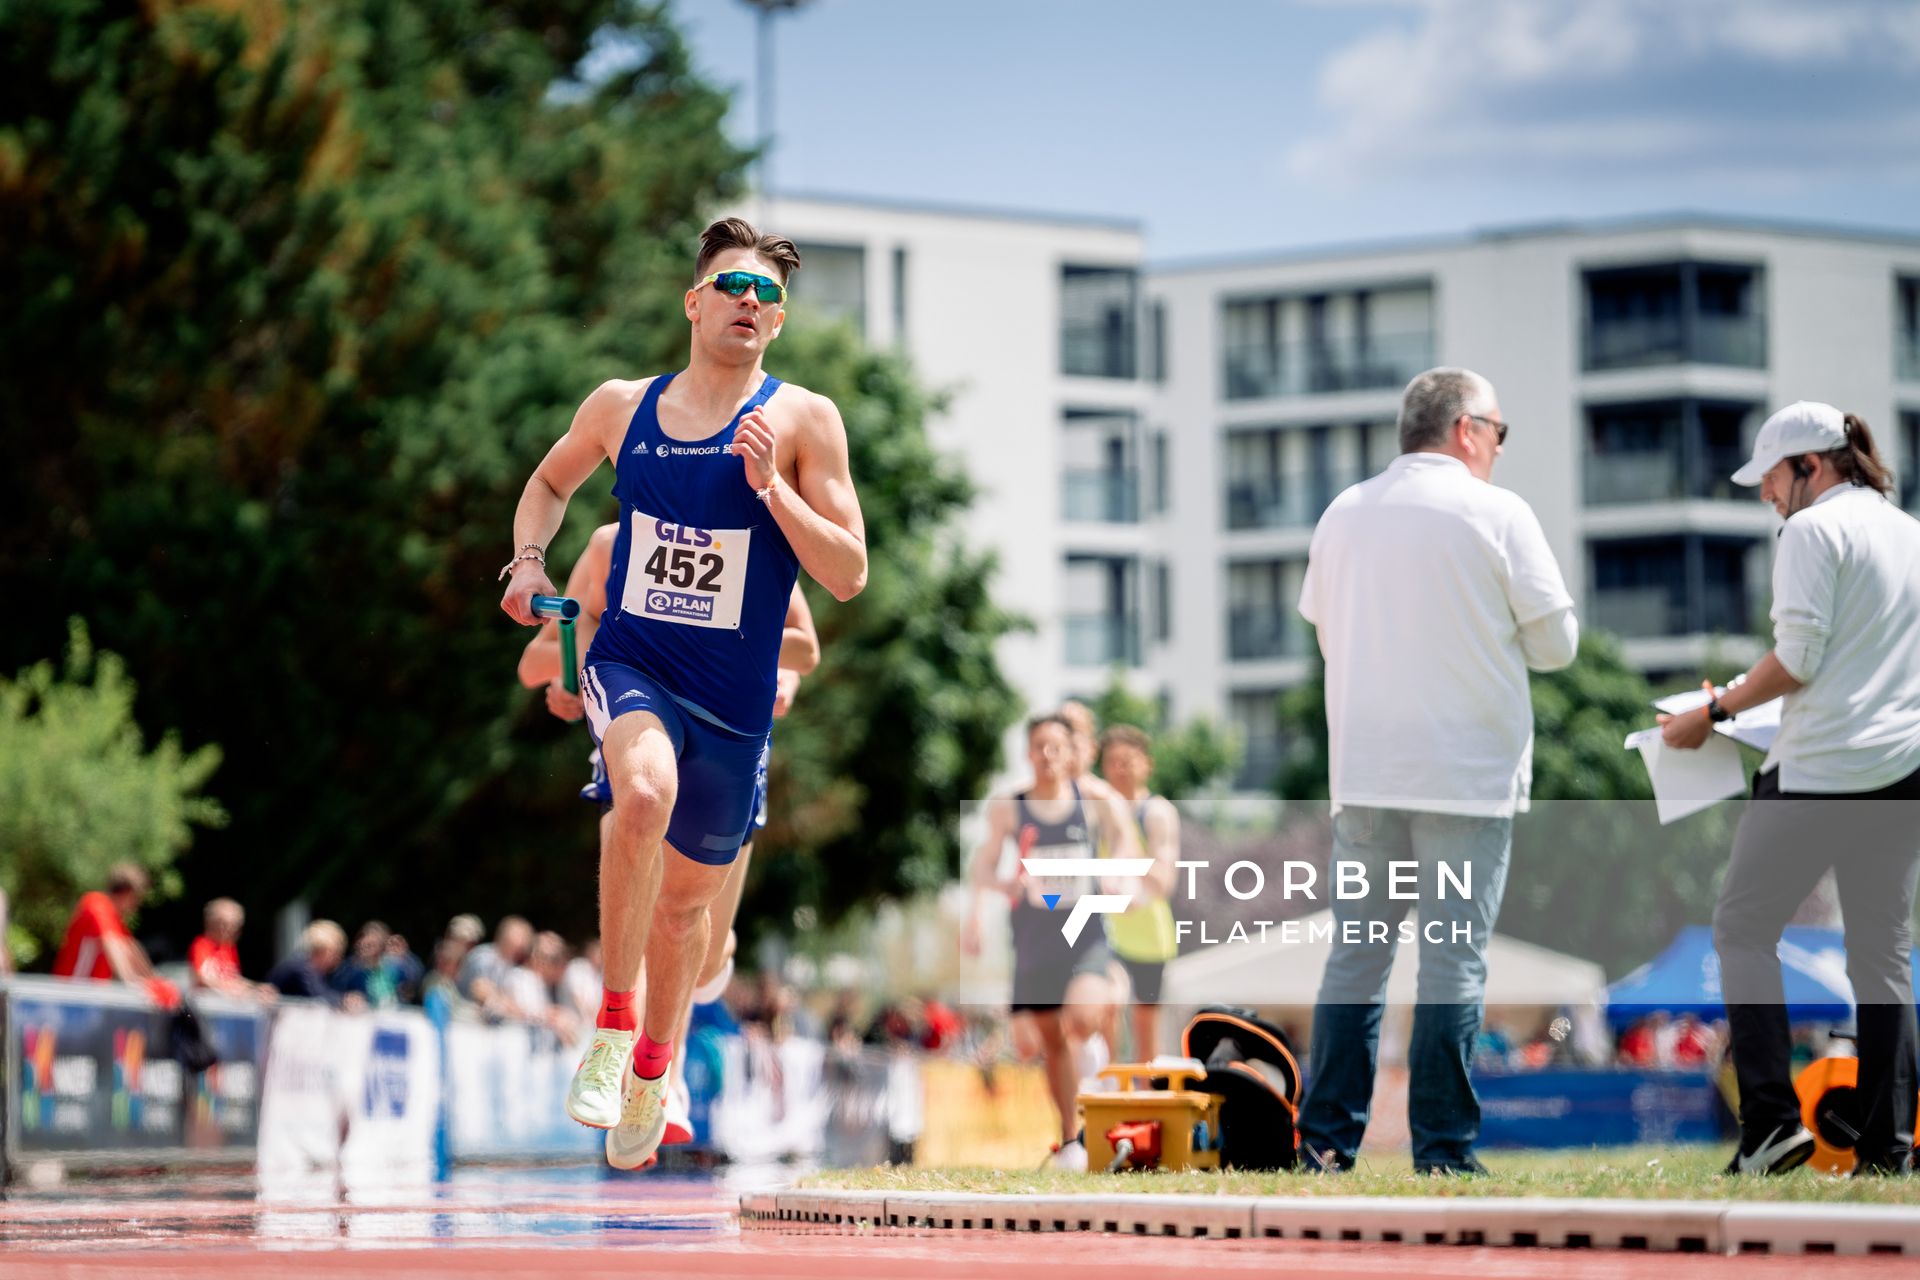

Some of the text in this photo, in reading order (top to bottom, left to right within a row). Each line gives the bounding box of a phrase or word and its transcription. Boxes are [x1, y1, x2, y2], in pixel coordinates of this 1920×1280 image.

[671, 446, 720, 456] NEUWOGES
[644, 545, 724, 593] 452
[673, 597, 711, 612] PLAN
